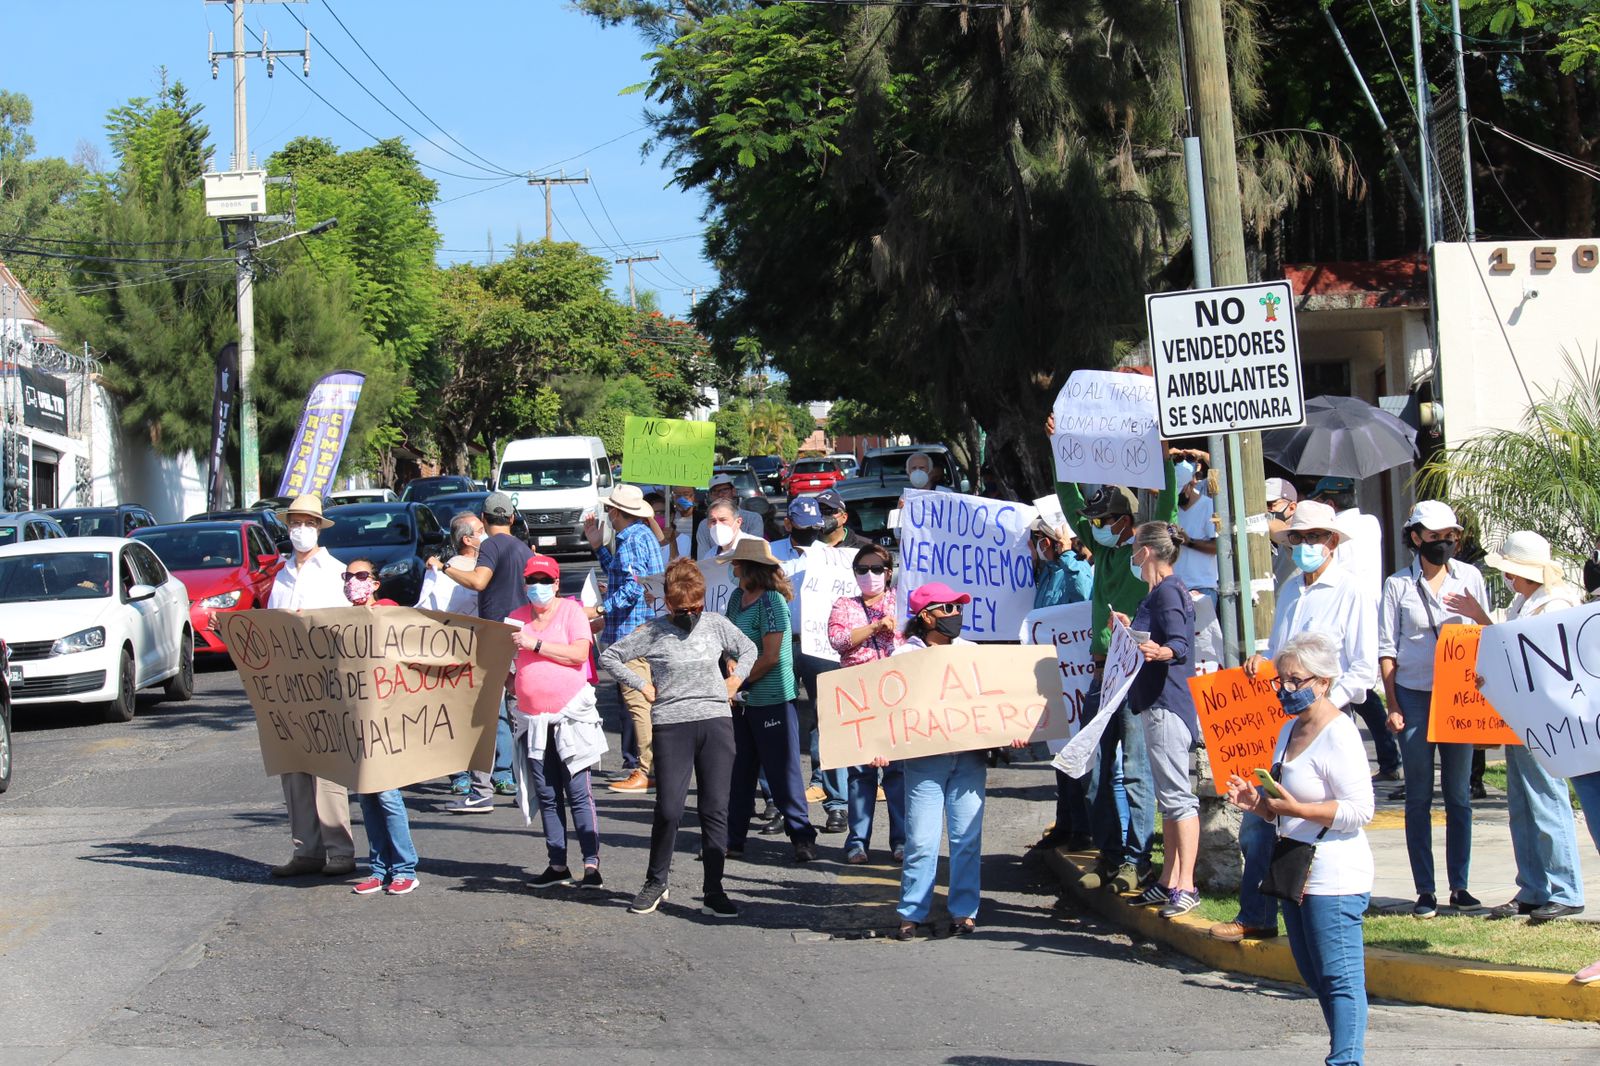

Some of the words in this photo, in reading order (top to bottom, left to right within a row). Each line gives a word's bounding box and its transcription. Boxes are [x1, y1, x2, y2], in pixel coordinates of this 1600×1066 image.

[1194, 297, 1246, 328] NO
[1162, 328, 1287, 364] VENDEDORES
[1061, 381, 1082, 399] NO
[1082, 381, 1103, 400] AL
[1167, 363, 1290, 398] AMBULANTES
[1099, 416, 1118, 432] DE
[1168, 406, 1188, 428] SE
[1192, 396, 1293, 426] SANCIONARA
[641, 420, 672, 438] NO
[803, 503, 817, 516] LA
[910, 499, 1016, 547] UNIDOS
[901, 537, 1037, 593] VENCEREMOS
[269, 627, 283, 651] A
[285, 624, 305, 660] LA
[1443, 635, 1466, 662] NO
[252, 674, 273, 703] DE
[277, 665, 343, 704] CAMIONES
[347, 670, 370, 701] DE
[372, 660, 475, 701] BASURA
[836, 669, 908, 719] NO
[940, 661, 1006, 702] AL
[1201, 685, 1228, 716] NO
[1231, 681, 1248, 702] AL
[1571, 683, 1586, 699] A
[269, 709, 294, 741] EN
[342, 703, 455, 764] CHALMA
[840, 702, 1049, 750] TIRADERO
[1210, 711, 1265, 741] BASURA
[1219, 738, 1268, 763] SUBIDA
